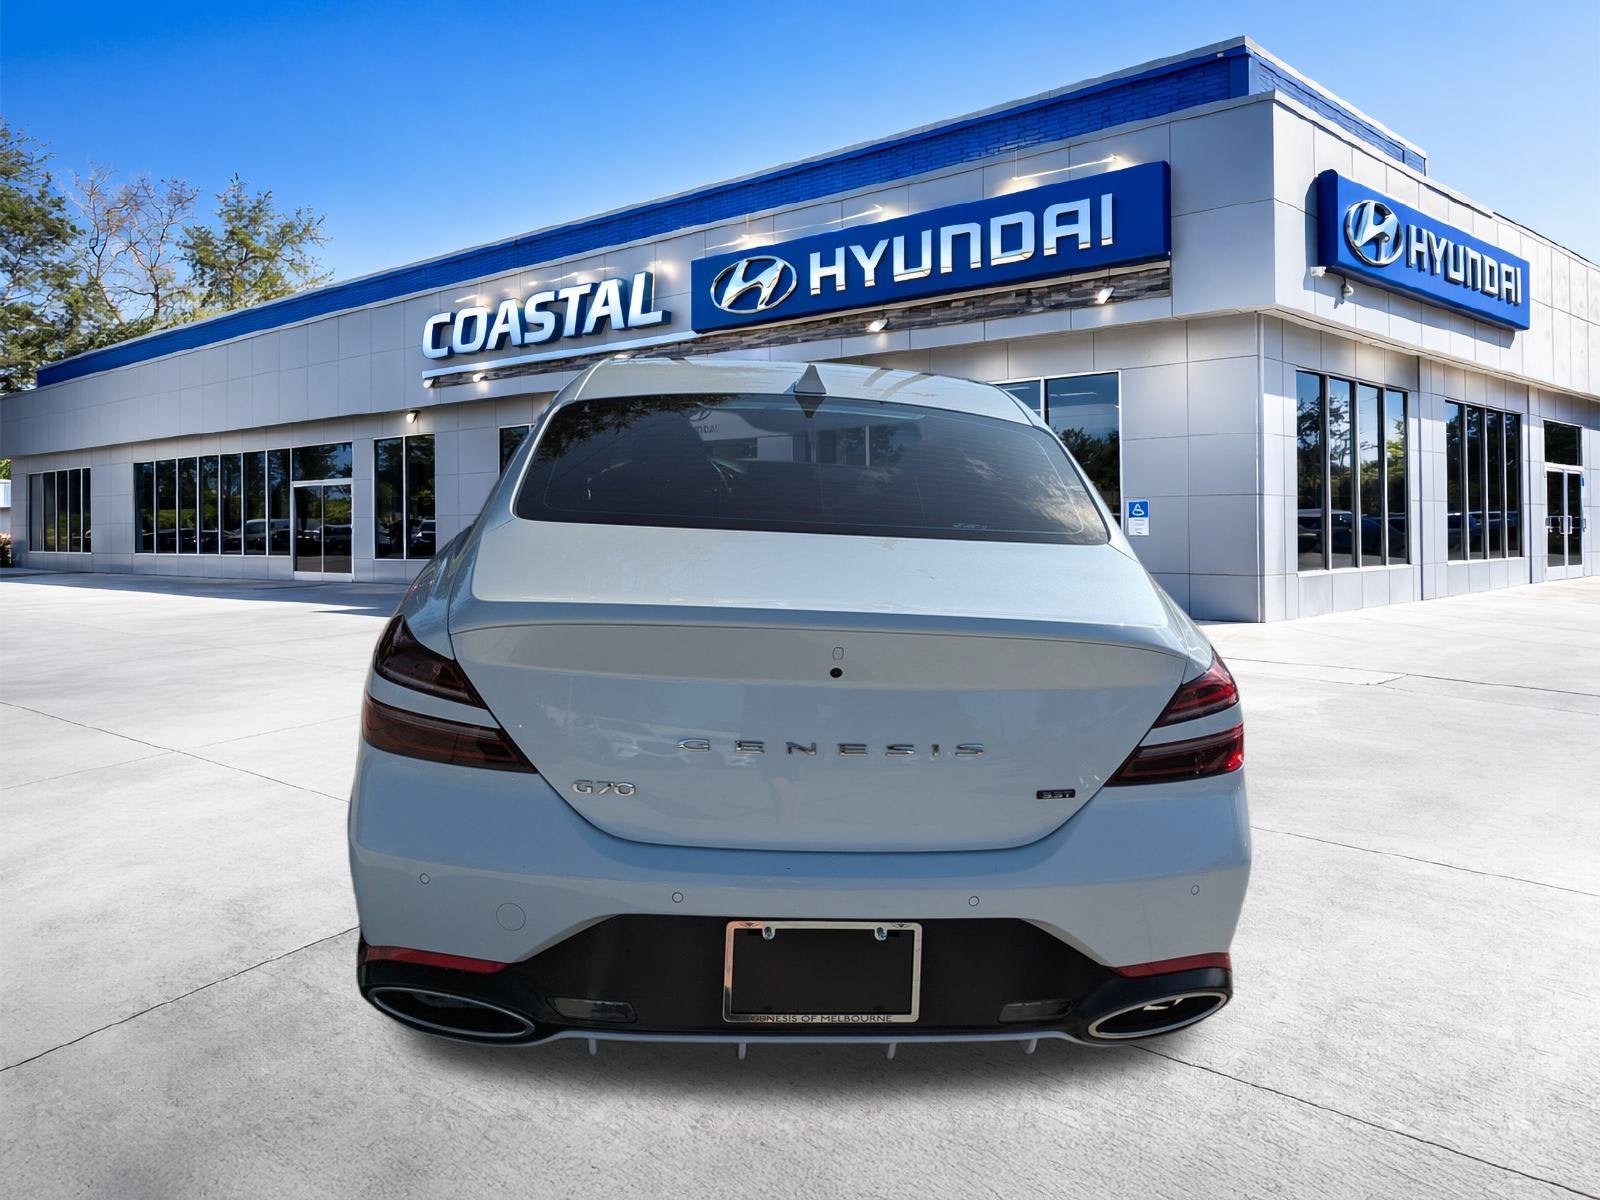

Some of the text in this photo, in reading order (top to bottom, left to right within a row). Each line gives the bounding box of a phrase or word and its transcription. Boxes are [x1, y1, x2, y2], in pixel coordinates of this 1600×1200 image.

[810, 193, 1113, 296] HYUNDAI
[1406, 224, 1522, 306] HYUNDAI
[422, 271, 671, 359] COASTAL
[676, 737, 985, 757] GENESIS
[572, 779, 636, 797] G70
[750, 1015, 893, 1023] GENESIS OF MELBOURNE
